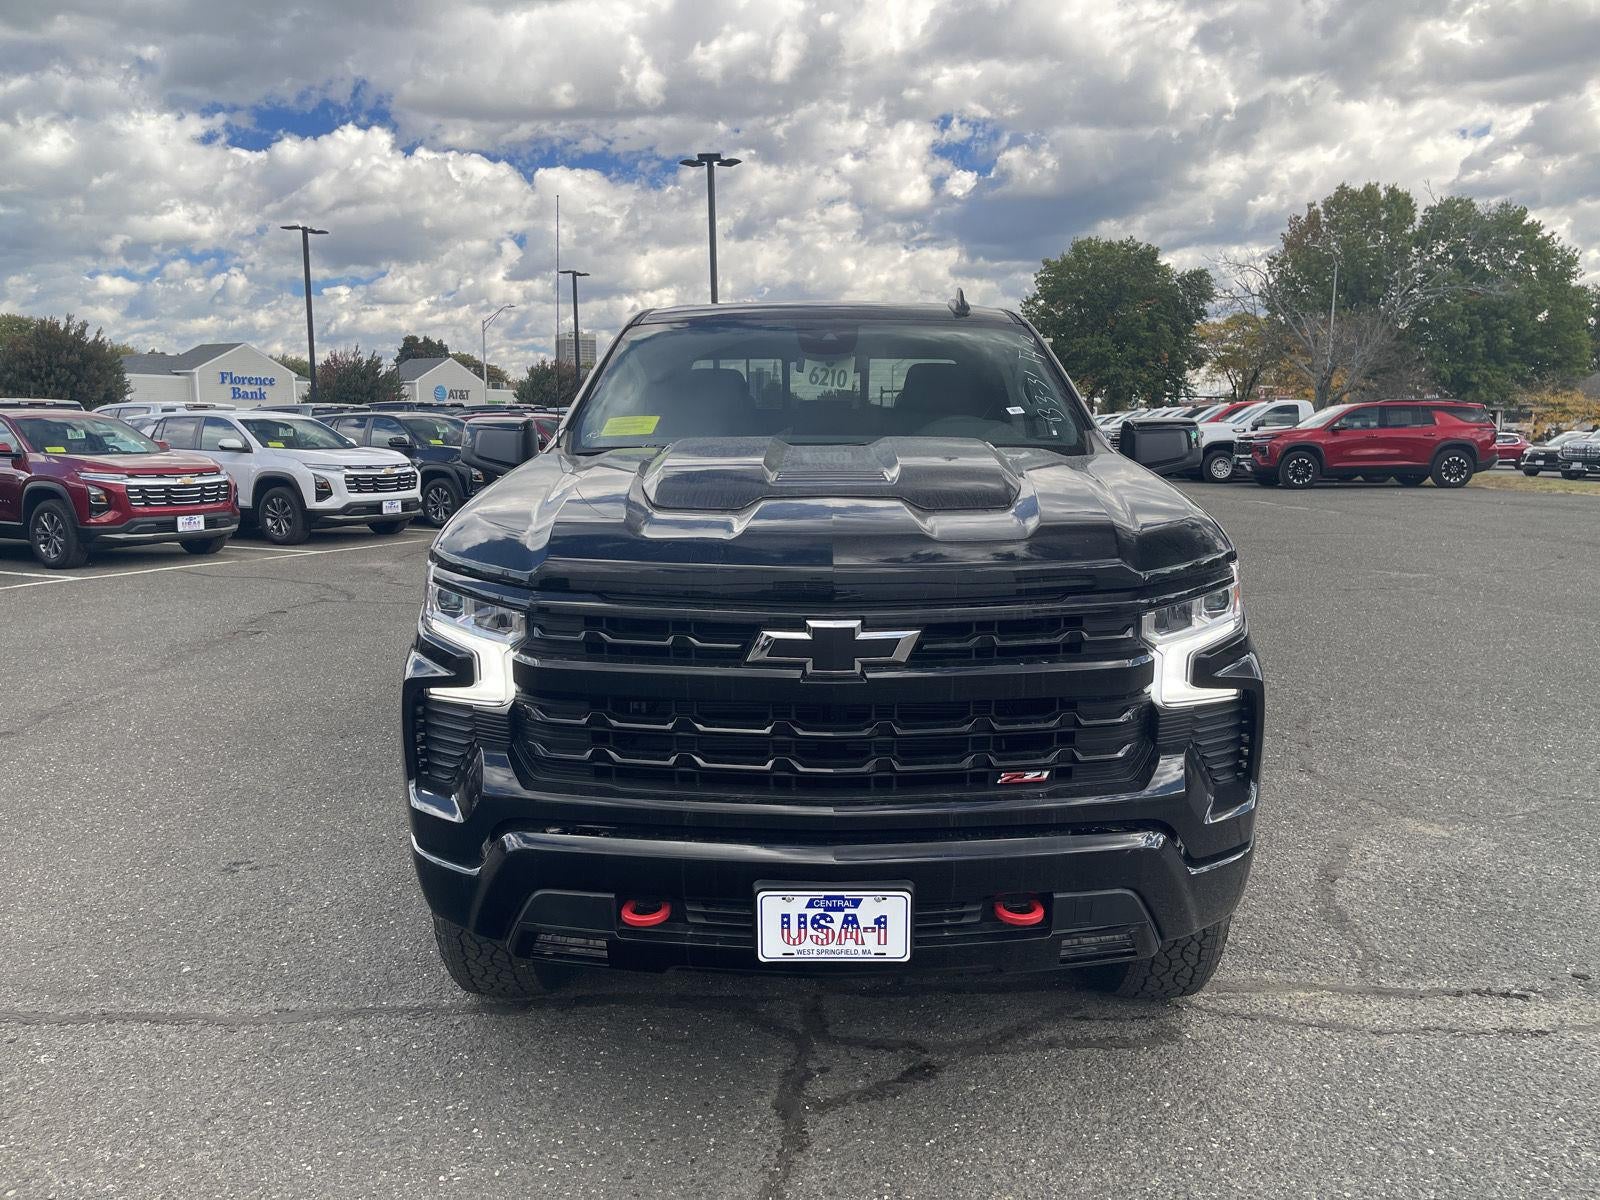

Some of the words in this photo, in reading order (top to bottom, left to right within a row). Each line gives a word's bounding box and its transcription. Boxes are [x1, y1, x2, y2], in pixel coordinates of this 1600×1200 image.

[219, 371, 276, 386] Florence
[808, 366, 848, 389] 6210
[231, 386, 267, 400] Bank
[448, 388, 471, 400] AT&T
[813, 899, 855, 908] CENTRAL
[780, 912, 888, 947] USA-1
[796, 948, 815, 956] WEST
[861, 948, 872, 956] MA
